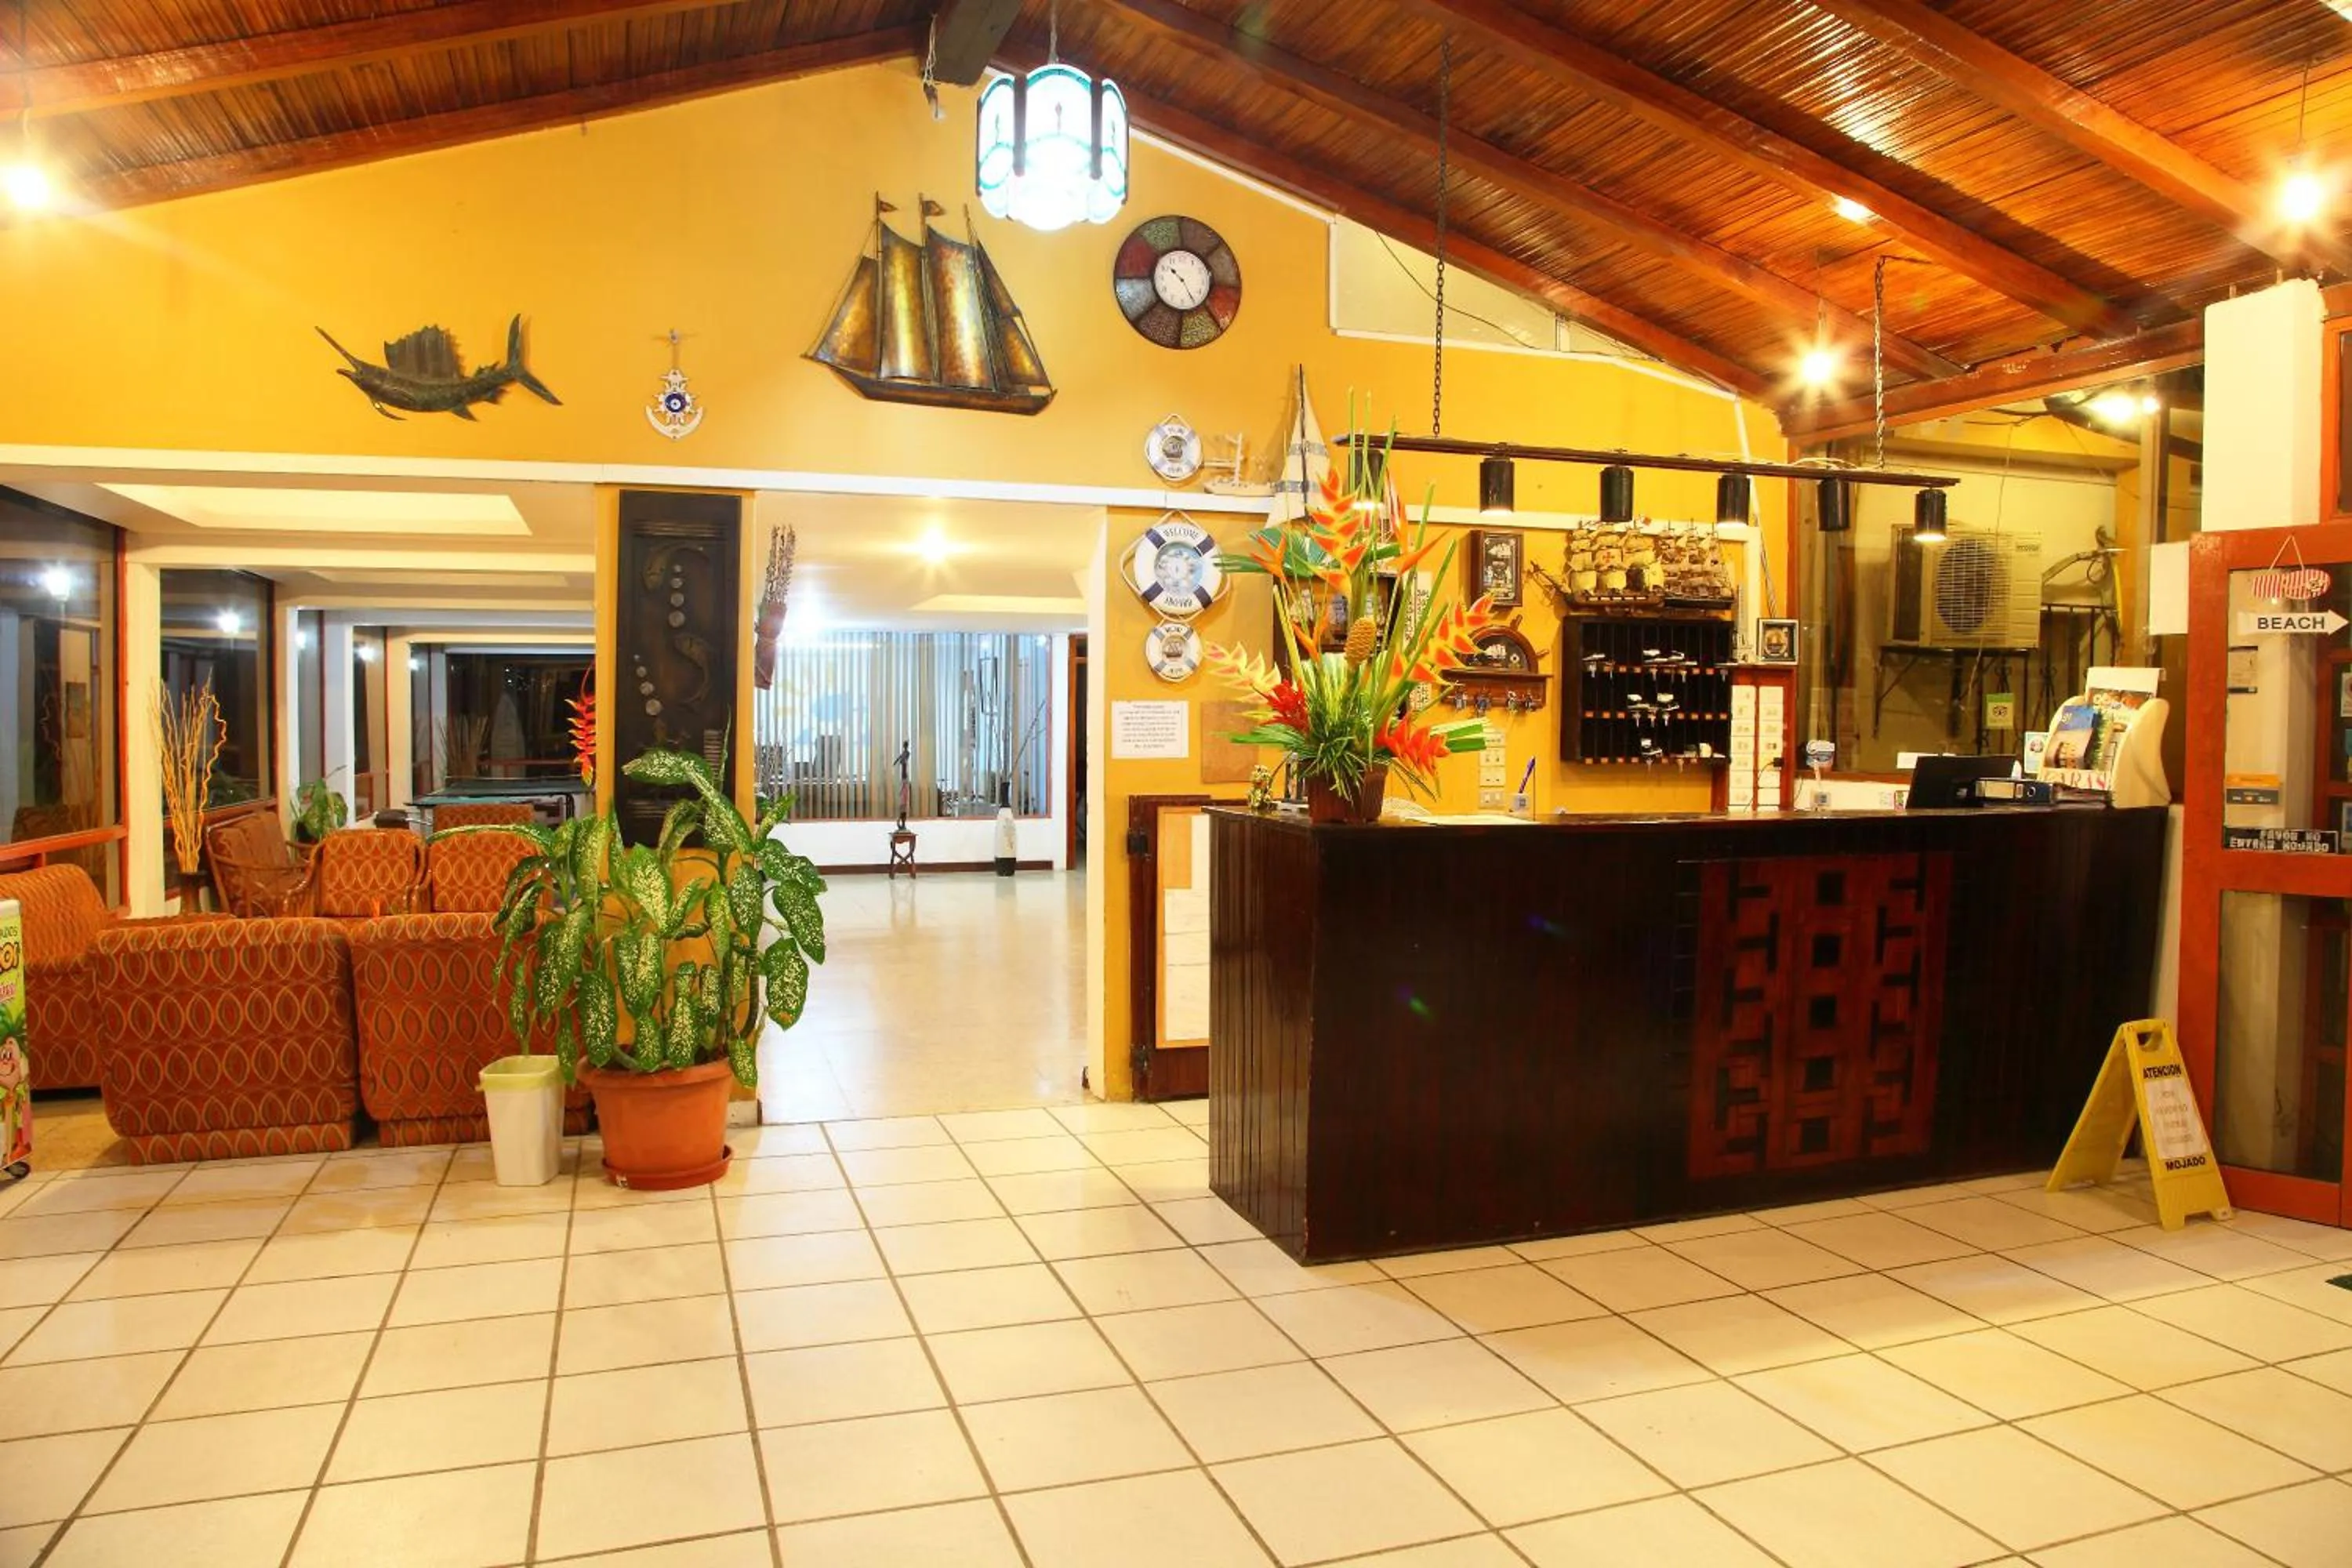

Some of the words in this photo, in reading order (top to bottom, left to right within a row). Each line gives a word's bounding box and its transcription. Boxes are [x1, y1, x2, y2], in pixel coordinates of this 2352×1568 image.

[1163, 527, 1199, 540] WELCOME
[2257, 615, 2325, 630] BEACH
[2260, 829, 2298, 840] FAVOR
[2305, 831, 2321, 841] NO
[2230, 837, 2275, 849] ENTRAR
[2282, 840, 2329, 852] MOJADO
[2143, 1064, 2181, 1080] ATENCION
[2165, 1156, 2205, 1171] MOJADO
